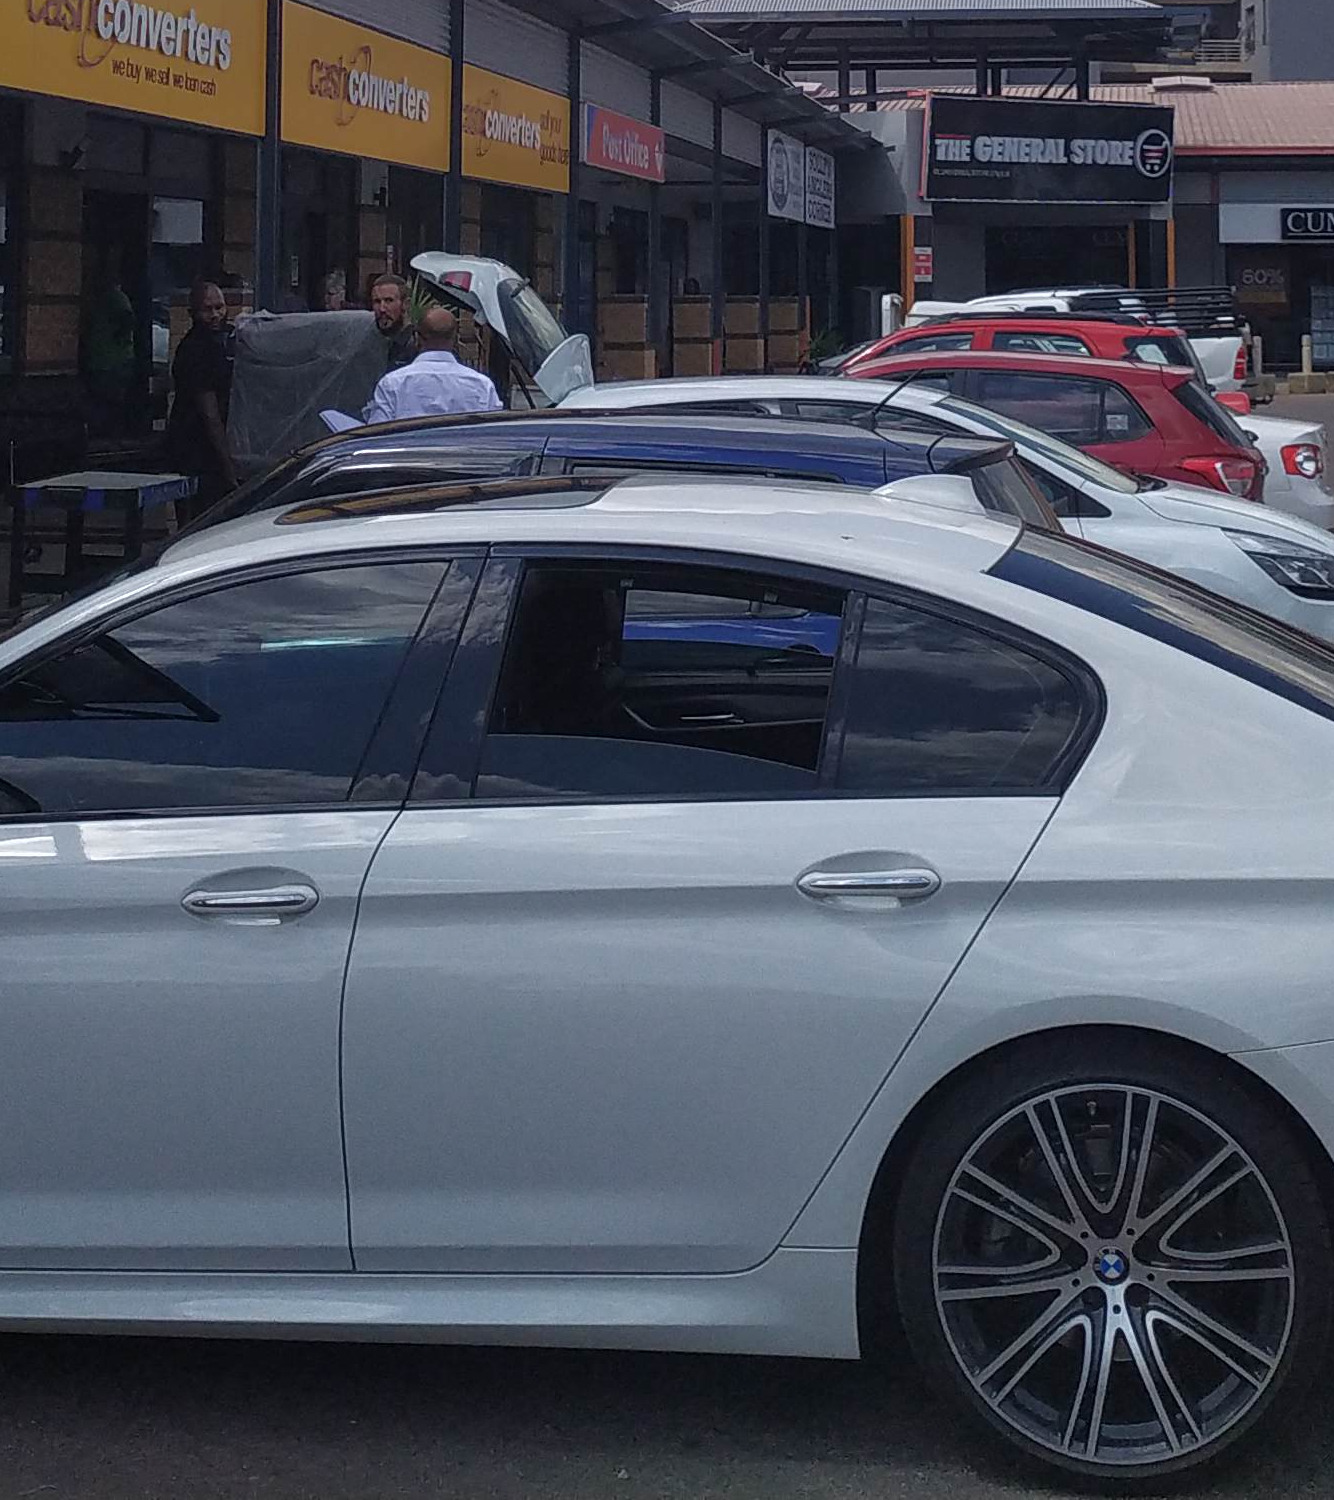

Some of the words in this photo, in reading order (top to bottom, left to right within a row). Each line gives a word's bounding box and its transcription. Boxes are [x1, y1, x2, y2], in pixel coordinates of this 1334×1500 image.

[307, 56, 348, 101] cash
[348, 68, 430, 123] converters
[484, 109, 541, 150] converters
[602, 121, 622, 163] Post
[623, 129, 649, 170] Office
[935, 139, 971, 162] THE
[974, 135, 1068, 164] GENERAL
[1070, 138, 1134, 165] STORE
